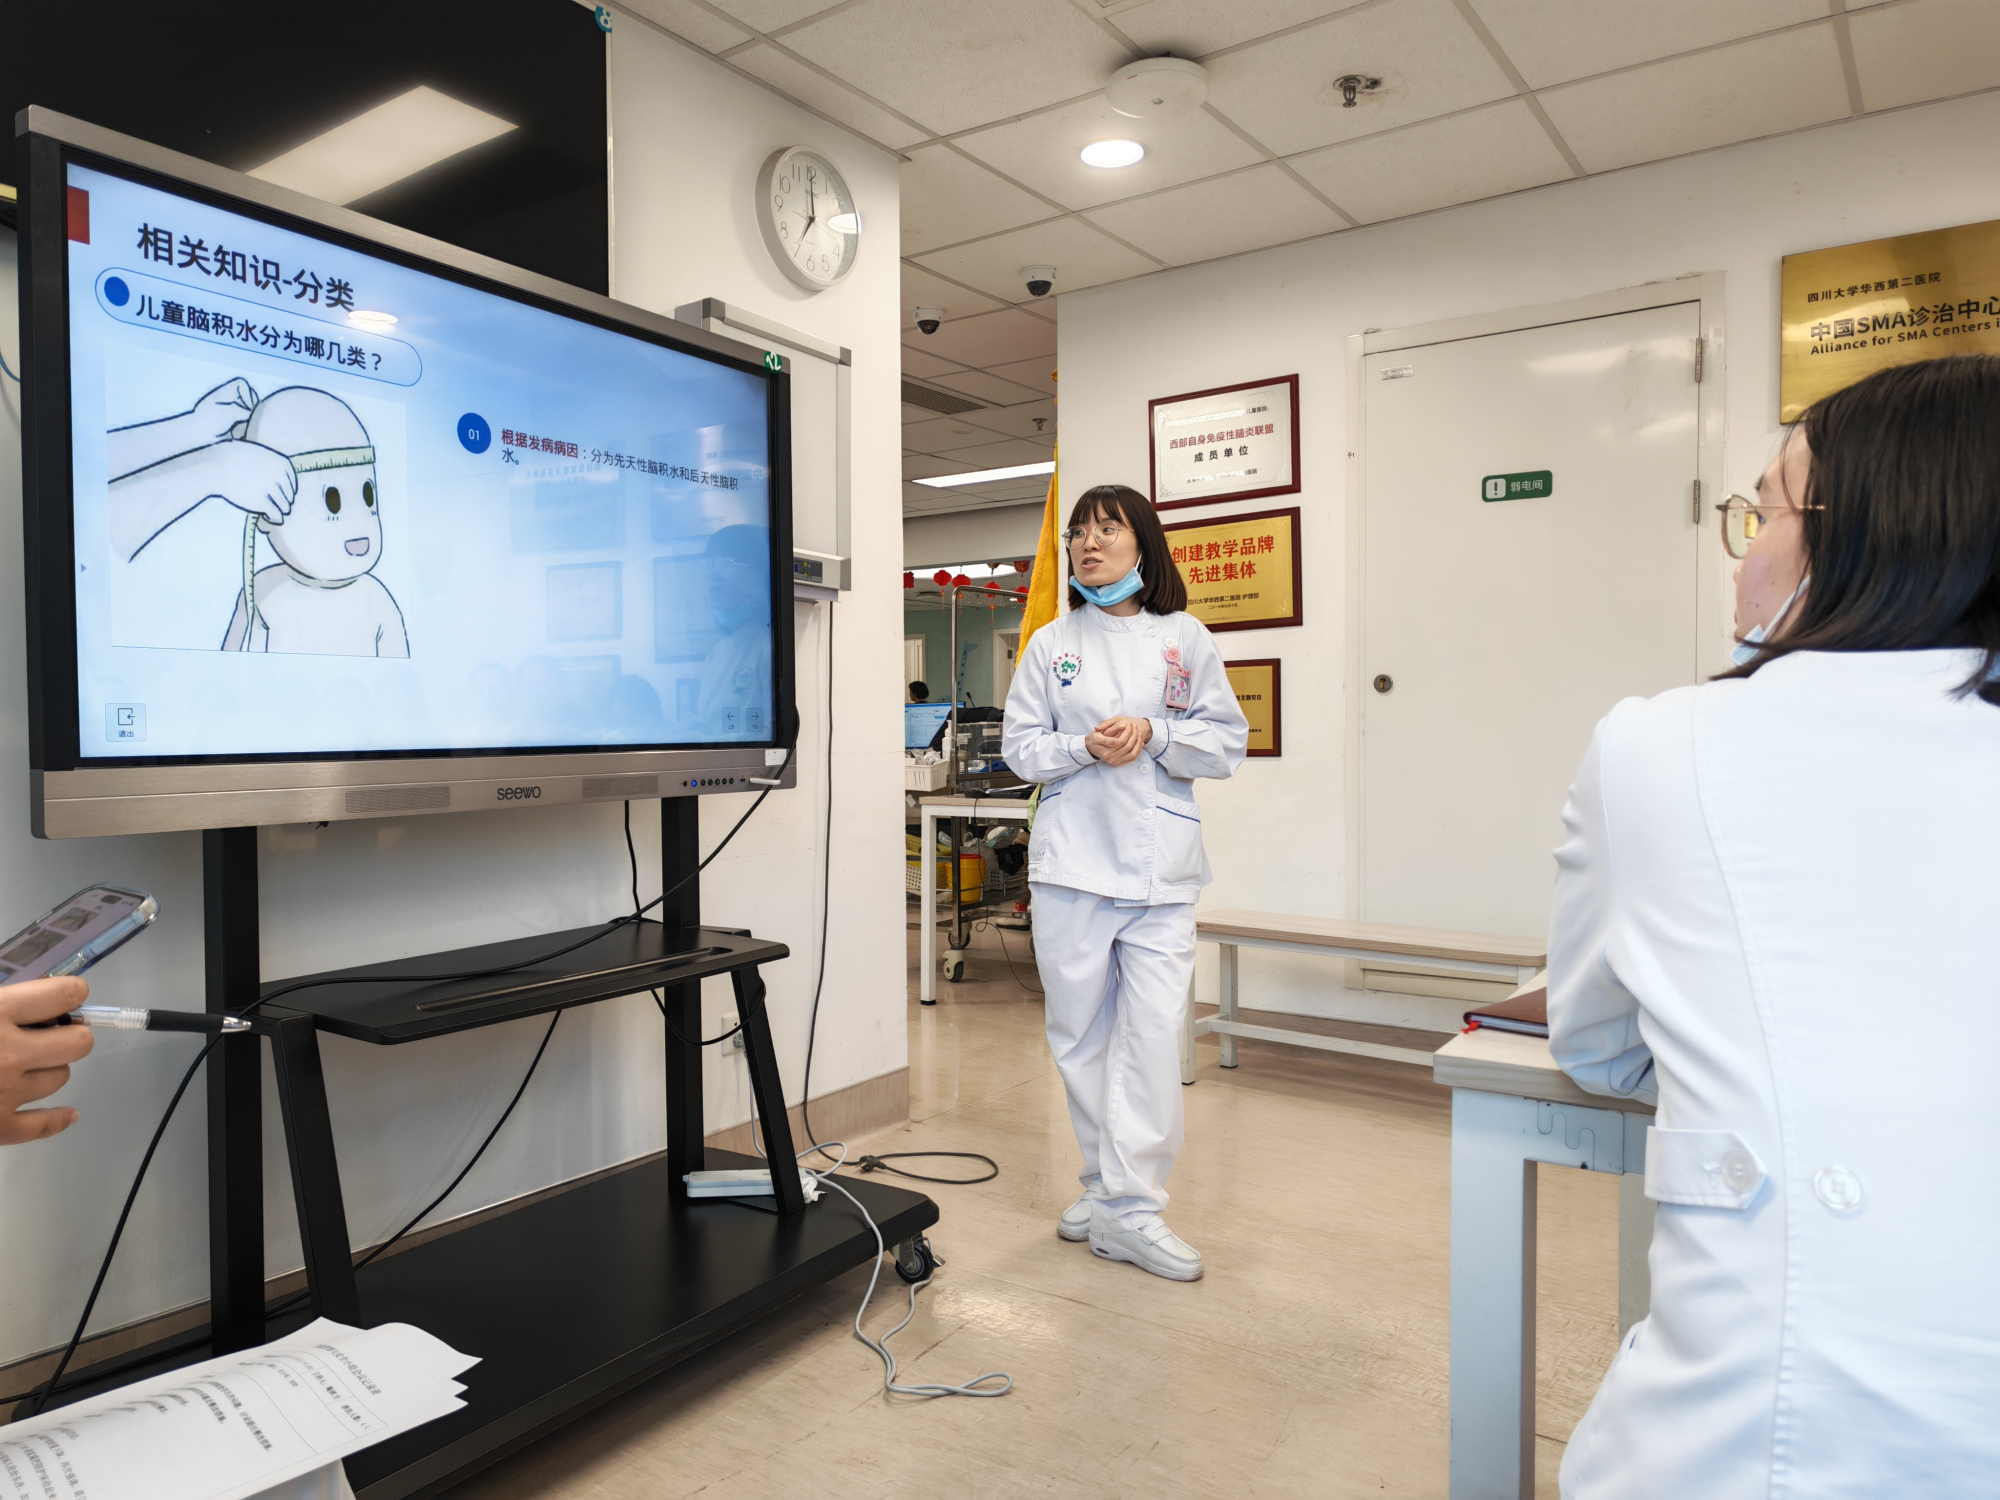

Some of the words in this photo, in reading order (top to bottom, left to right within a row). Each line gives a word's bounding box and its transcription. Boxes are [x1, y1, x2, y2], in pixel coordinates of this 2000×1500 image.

[779, 173, 791, 194] 10
[774, 194, 784, 213] 9
[779, 221, 789, 240] 8
[832, 243, 840, 261] 4
[136, 222, 355, 312] 相关知识-分类
[806, 254, 815, 272] 6
[821, 254, 830, 272] 5
[1807, 271, 1942, 303] 四川大学华西第二医院
[1810, 296, 2000, 342] 中国SMA诊治中心
[135, 294, 382, 371] 儿童脑积水分为哪几类？
[1811, 339, 1867, 355] Alliance
[1872, 334, 1893, 346] for
[1897, 329, 1928, 343] SMA
[1932, 319, 1991, 337] Centers
[468, 428, 480, 441] 01
[1169, 423, 1274, 450] 西部自身免疫性脑炎联盟
[501, 448, 519, 466] 水。
[1194, 445, 1249, 463] 成员单位
[1510, 479, 1543, 492] 弱电间
[1172, 534, 1275, 564] 创建教学品牌
[1188, 560, 1257, 585] 先进集体
[496, 785, 541, 801] seewo
